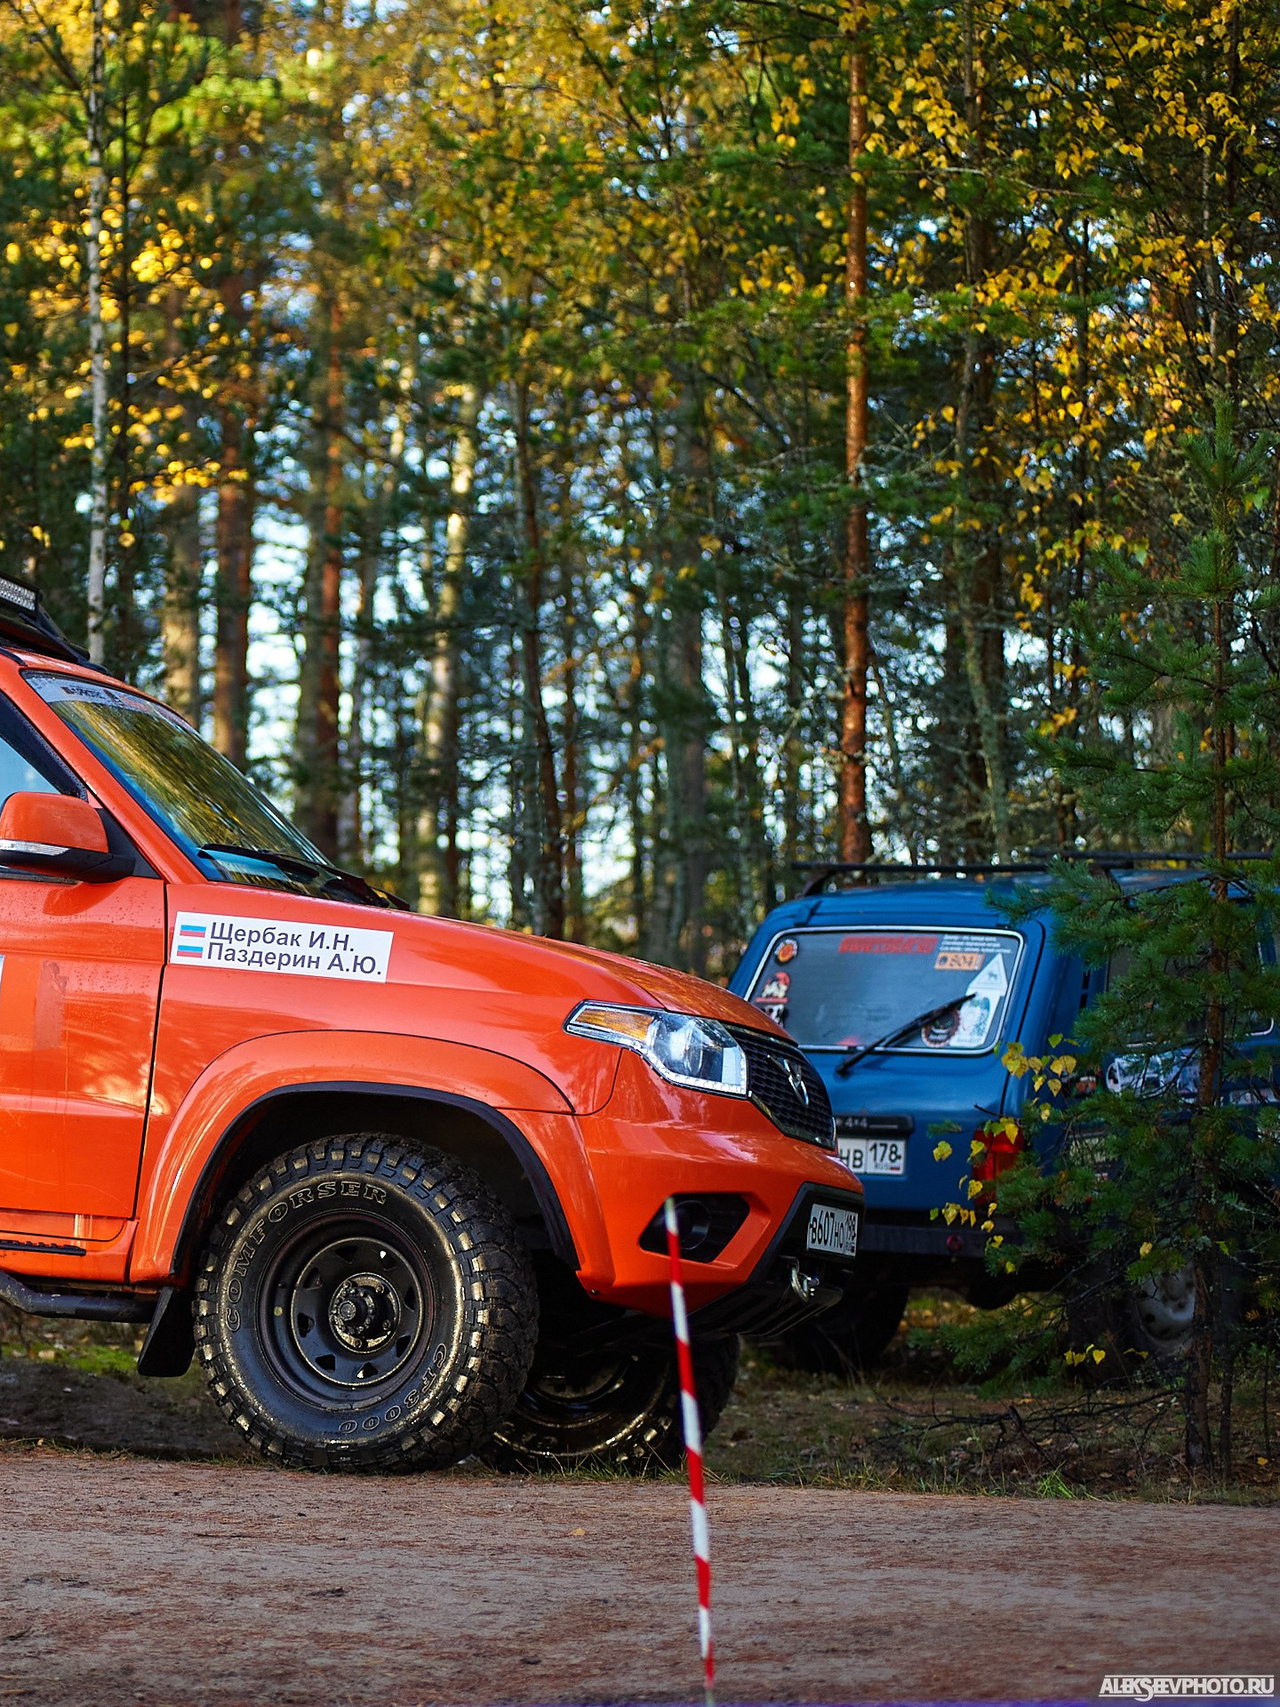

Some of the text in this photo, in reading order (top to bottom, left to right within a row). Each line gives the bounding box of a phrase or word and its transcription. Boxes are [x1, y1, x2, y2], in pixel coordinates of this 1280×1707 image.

[210, 921, 355, 952] Щербак И.Н.
[207, 942, 382, 976] Паздерин А.Ю.
[869, 1143, 899, 1164] 178
[225, 1181, 388, 1333] COMFORSER
[338, 1343, 448, 1434] CF3000
